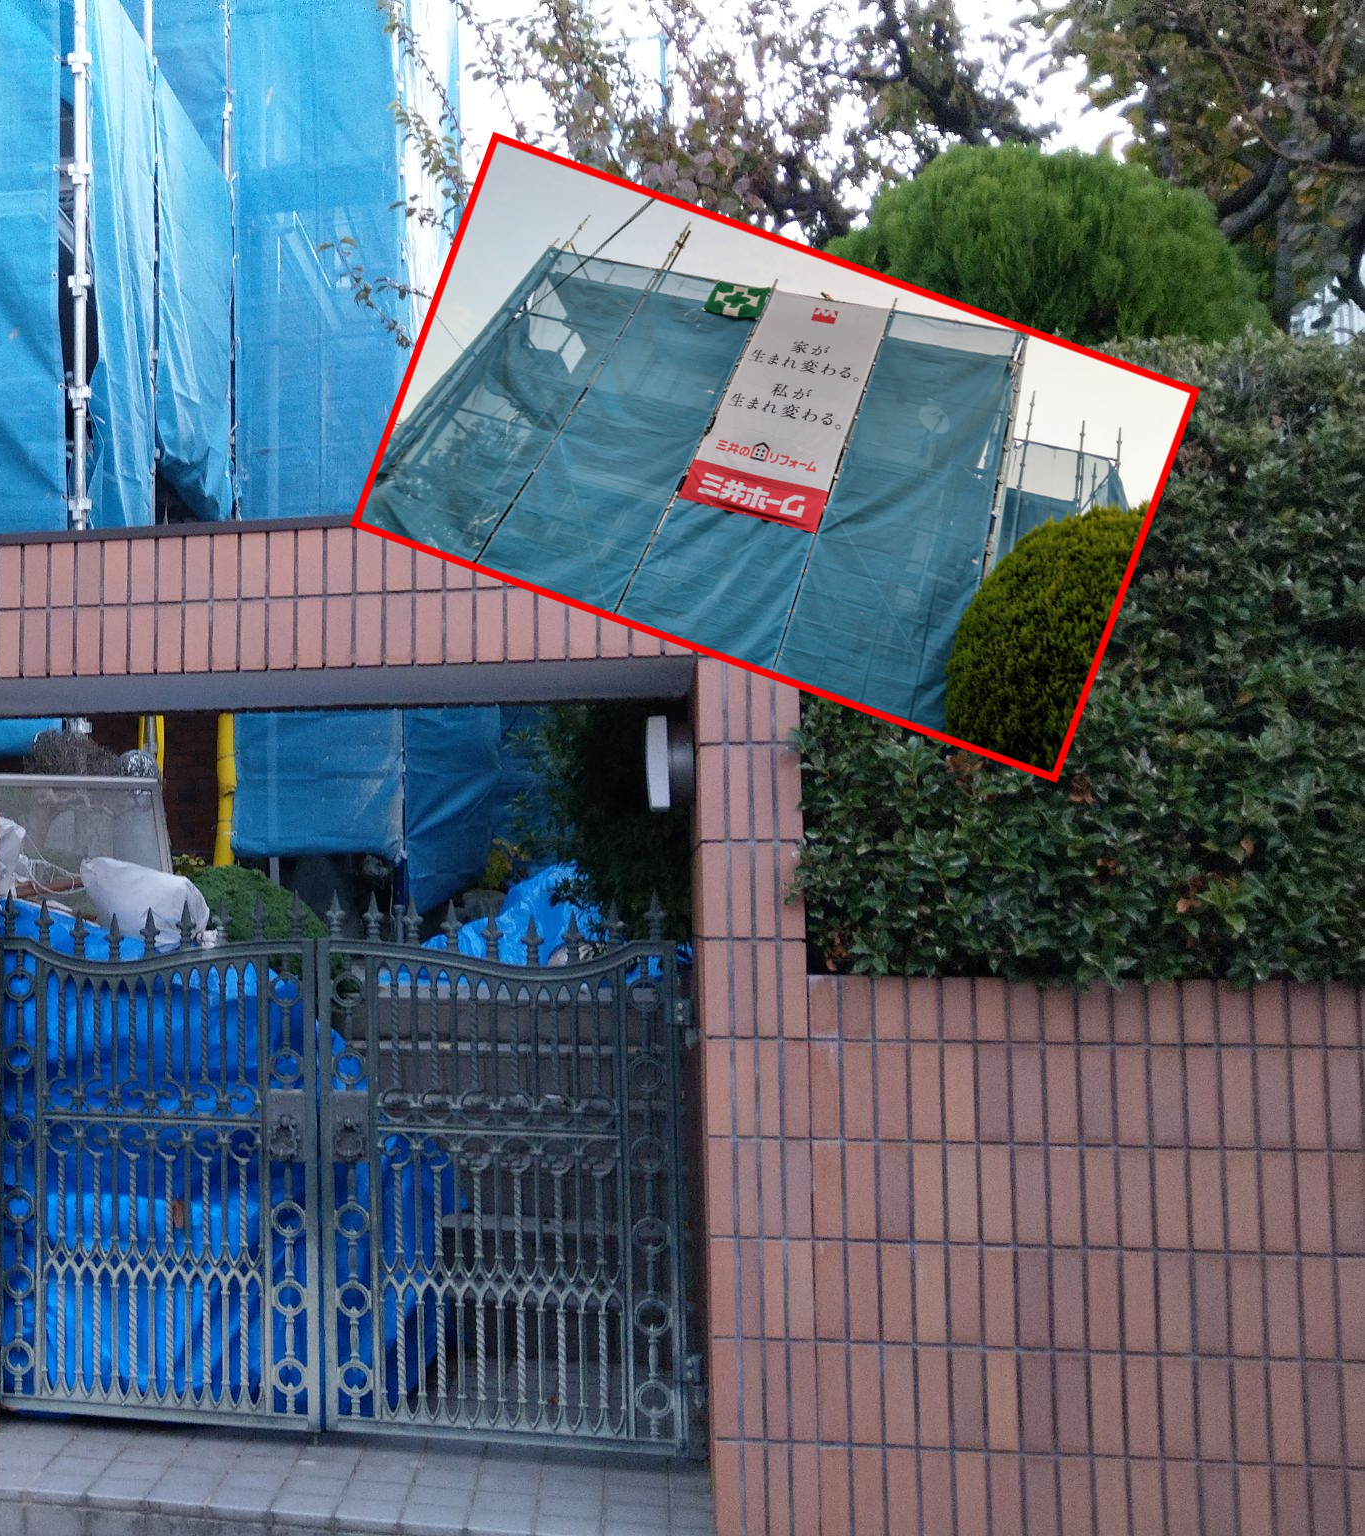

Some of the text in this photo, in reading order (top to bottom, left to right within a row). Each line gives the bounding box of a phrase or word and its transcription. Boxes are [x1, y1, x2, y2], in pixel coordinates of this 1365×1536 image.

[791, 340, 830, 356] 家が
[748, 349, 859, 382] 生まれ変わる。
[771, 383, 812, 400] 私が
[728, 393, 842, 430] 生まれ変わる。
[697, 472, 806, 518] 三井ホーム
